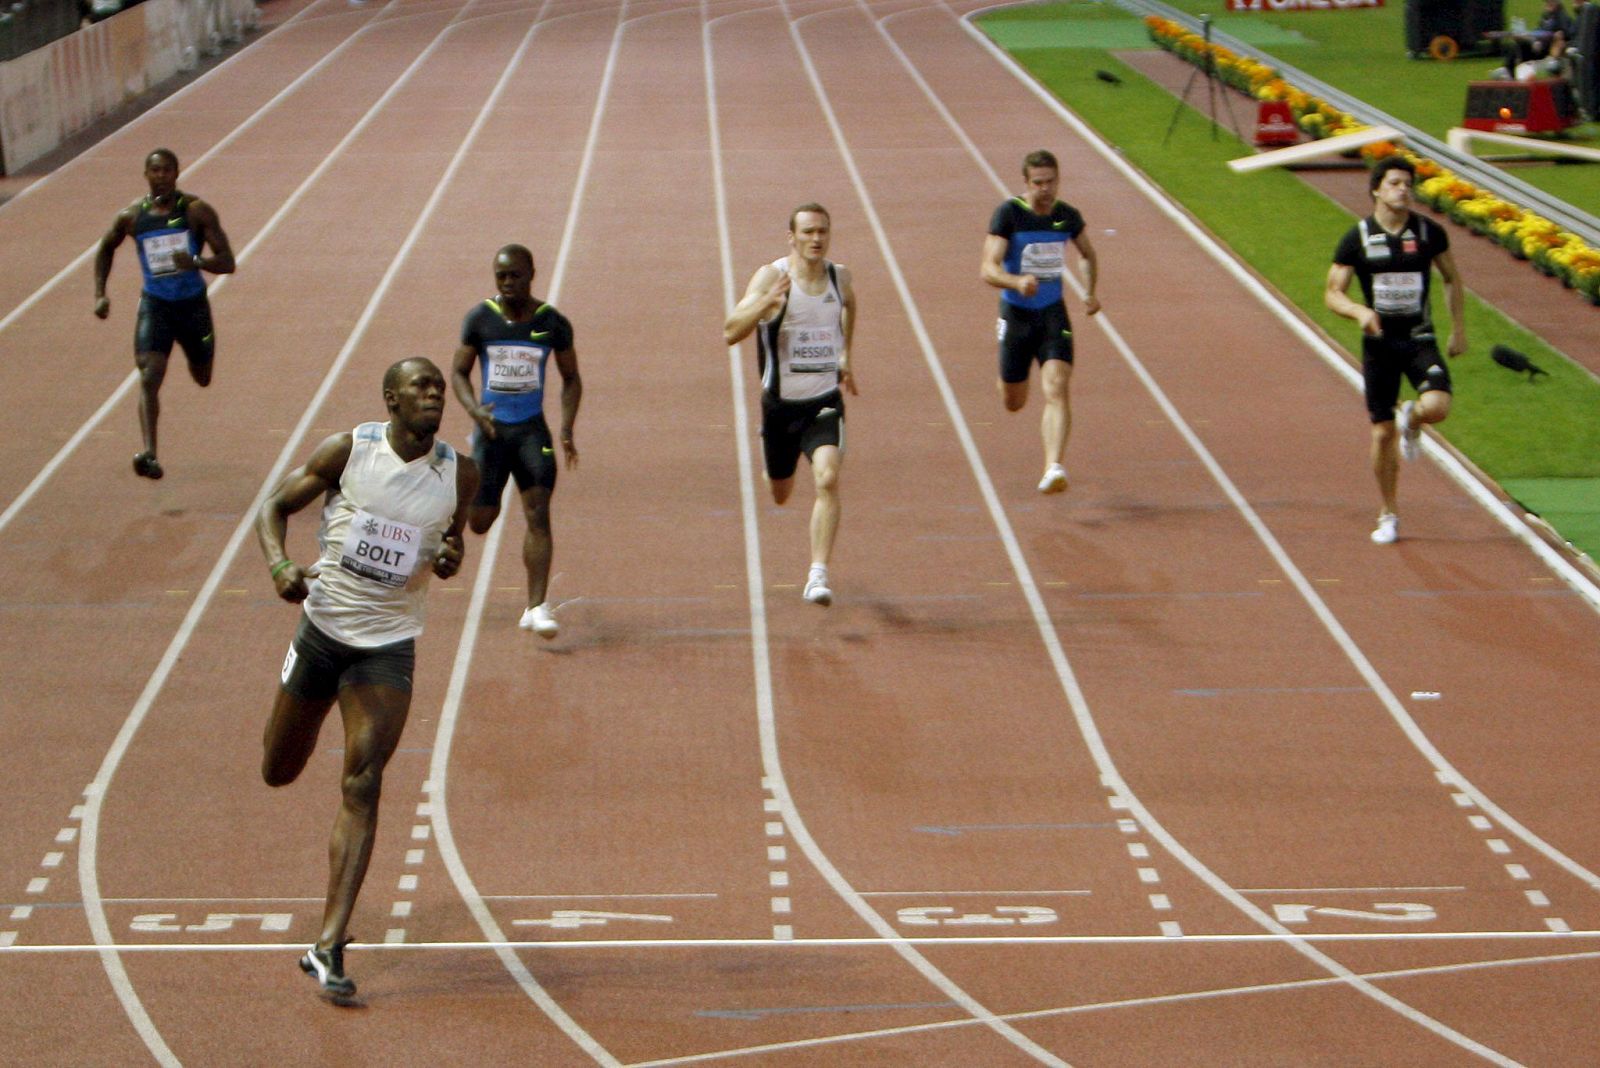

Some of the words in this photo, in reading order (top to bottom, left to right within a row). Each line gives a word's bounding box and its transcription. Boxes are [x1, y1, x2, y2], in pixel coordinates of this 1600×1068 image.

[381, 524, 412, 543] UBS
[356, 540, 405, 566] BOLT
[897, 906, 1058, 925] 3
[1272, 903, 1438, 922] 2
